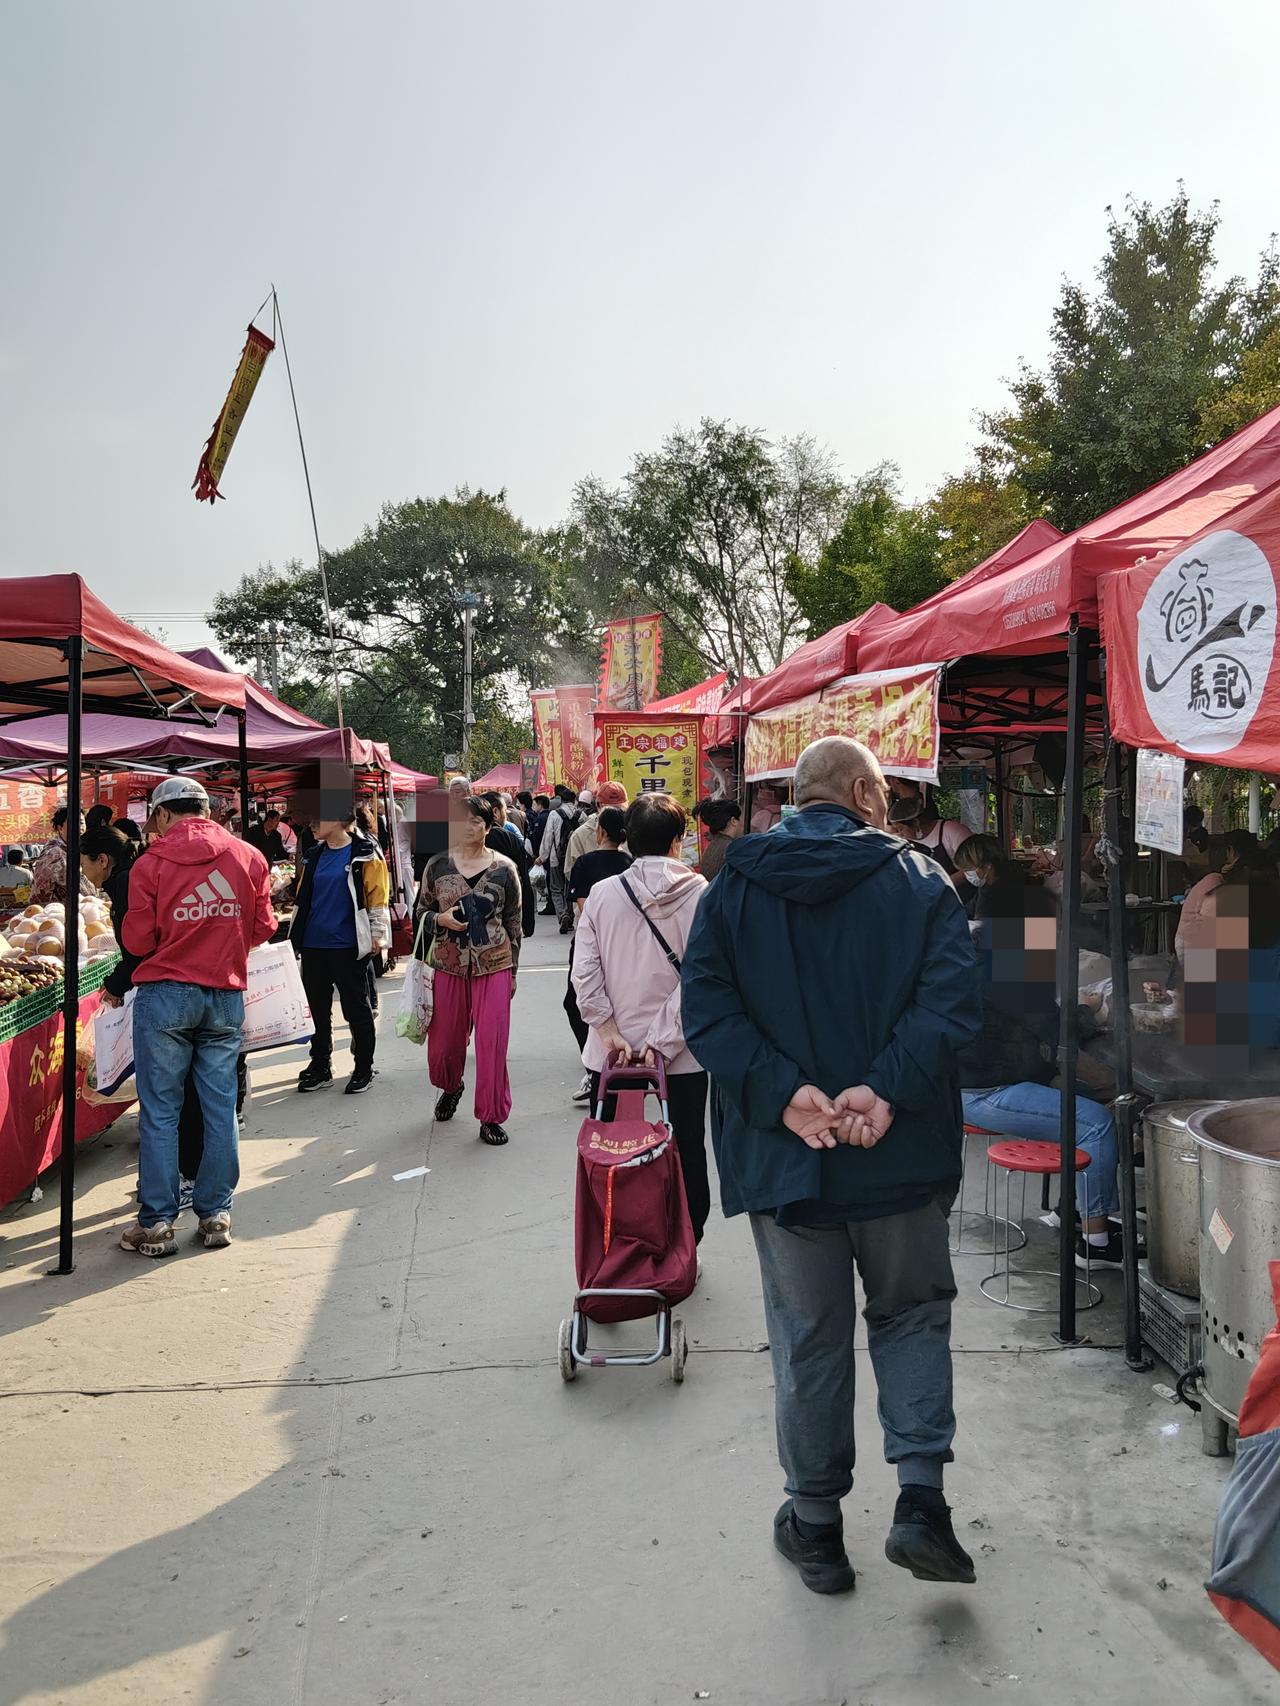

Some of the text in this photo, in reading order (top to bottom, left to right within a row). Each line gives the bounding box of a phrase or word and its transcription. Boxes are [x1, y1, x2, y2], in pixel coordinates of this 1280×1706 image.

[1187, 662, 1247, 712] 馬記
[618, 735, 687, 750] 正宗福建
[634, 754, 672, 796] 千里
[173, 900, 242, 922] adidas
